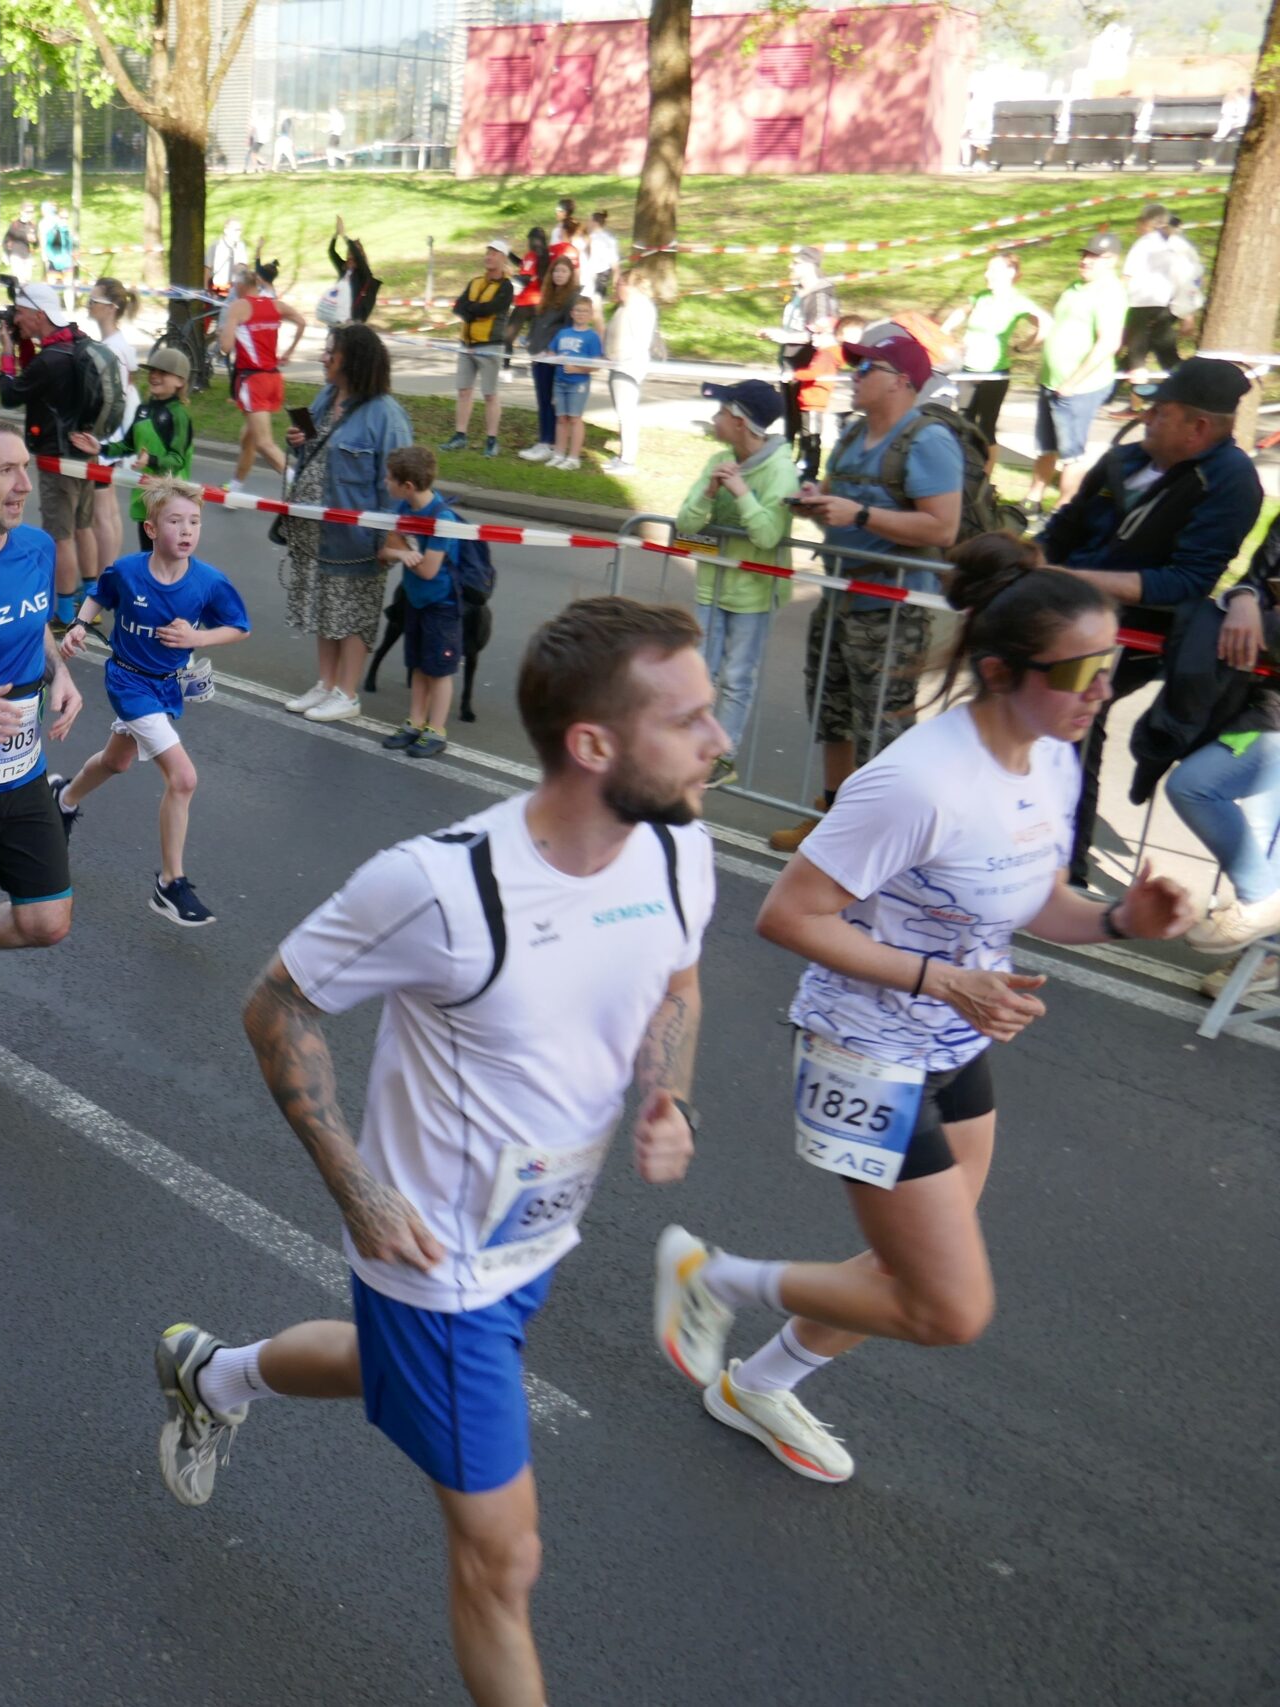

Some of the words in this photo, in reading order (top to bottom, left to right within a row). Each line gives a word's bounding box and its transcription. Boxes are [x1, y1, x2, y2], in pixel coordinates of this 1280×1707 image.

[20, 591, 49, 619] AG
[1, 728, 35, 753] 903
[592, 900, 666, 926] SIEMENS
[807, 1082, 895, 1132] 1825
[833, 1152, 887, 1178] AG
